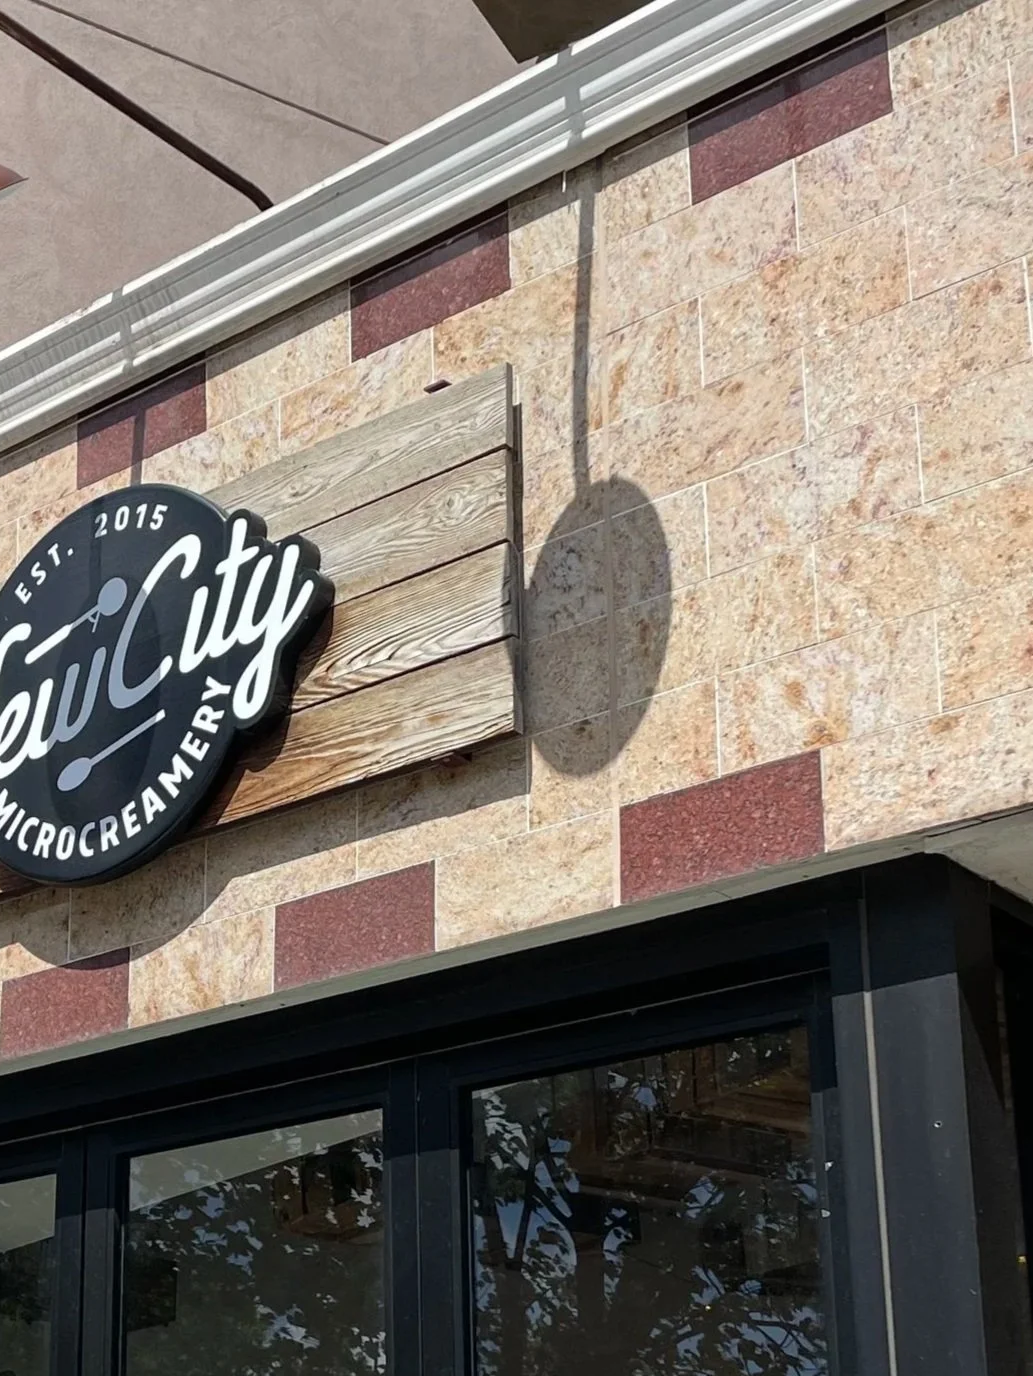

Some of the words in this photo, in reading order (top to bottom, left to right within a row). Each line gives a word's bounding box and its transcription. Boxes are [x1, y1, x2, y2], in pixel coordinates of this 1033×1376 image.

[14, 543, 74, 605] EST.
[94, 503, 168, 538] 2015
[107, 517, 314, 721] City
